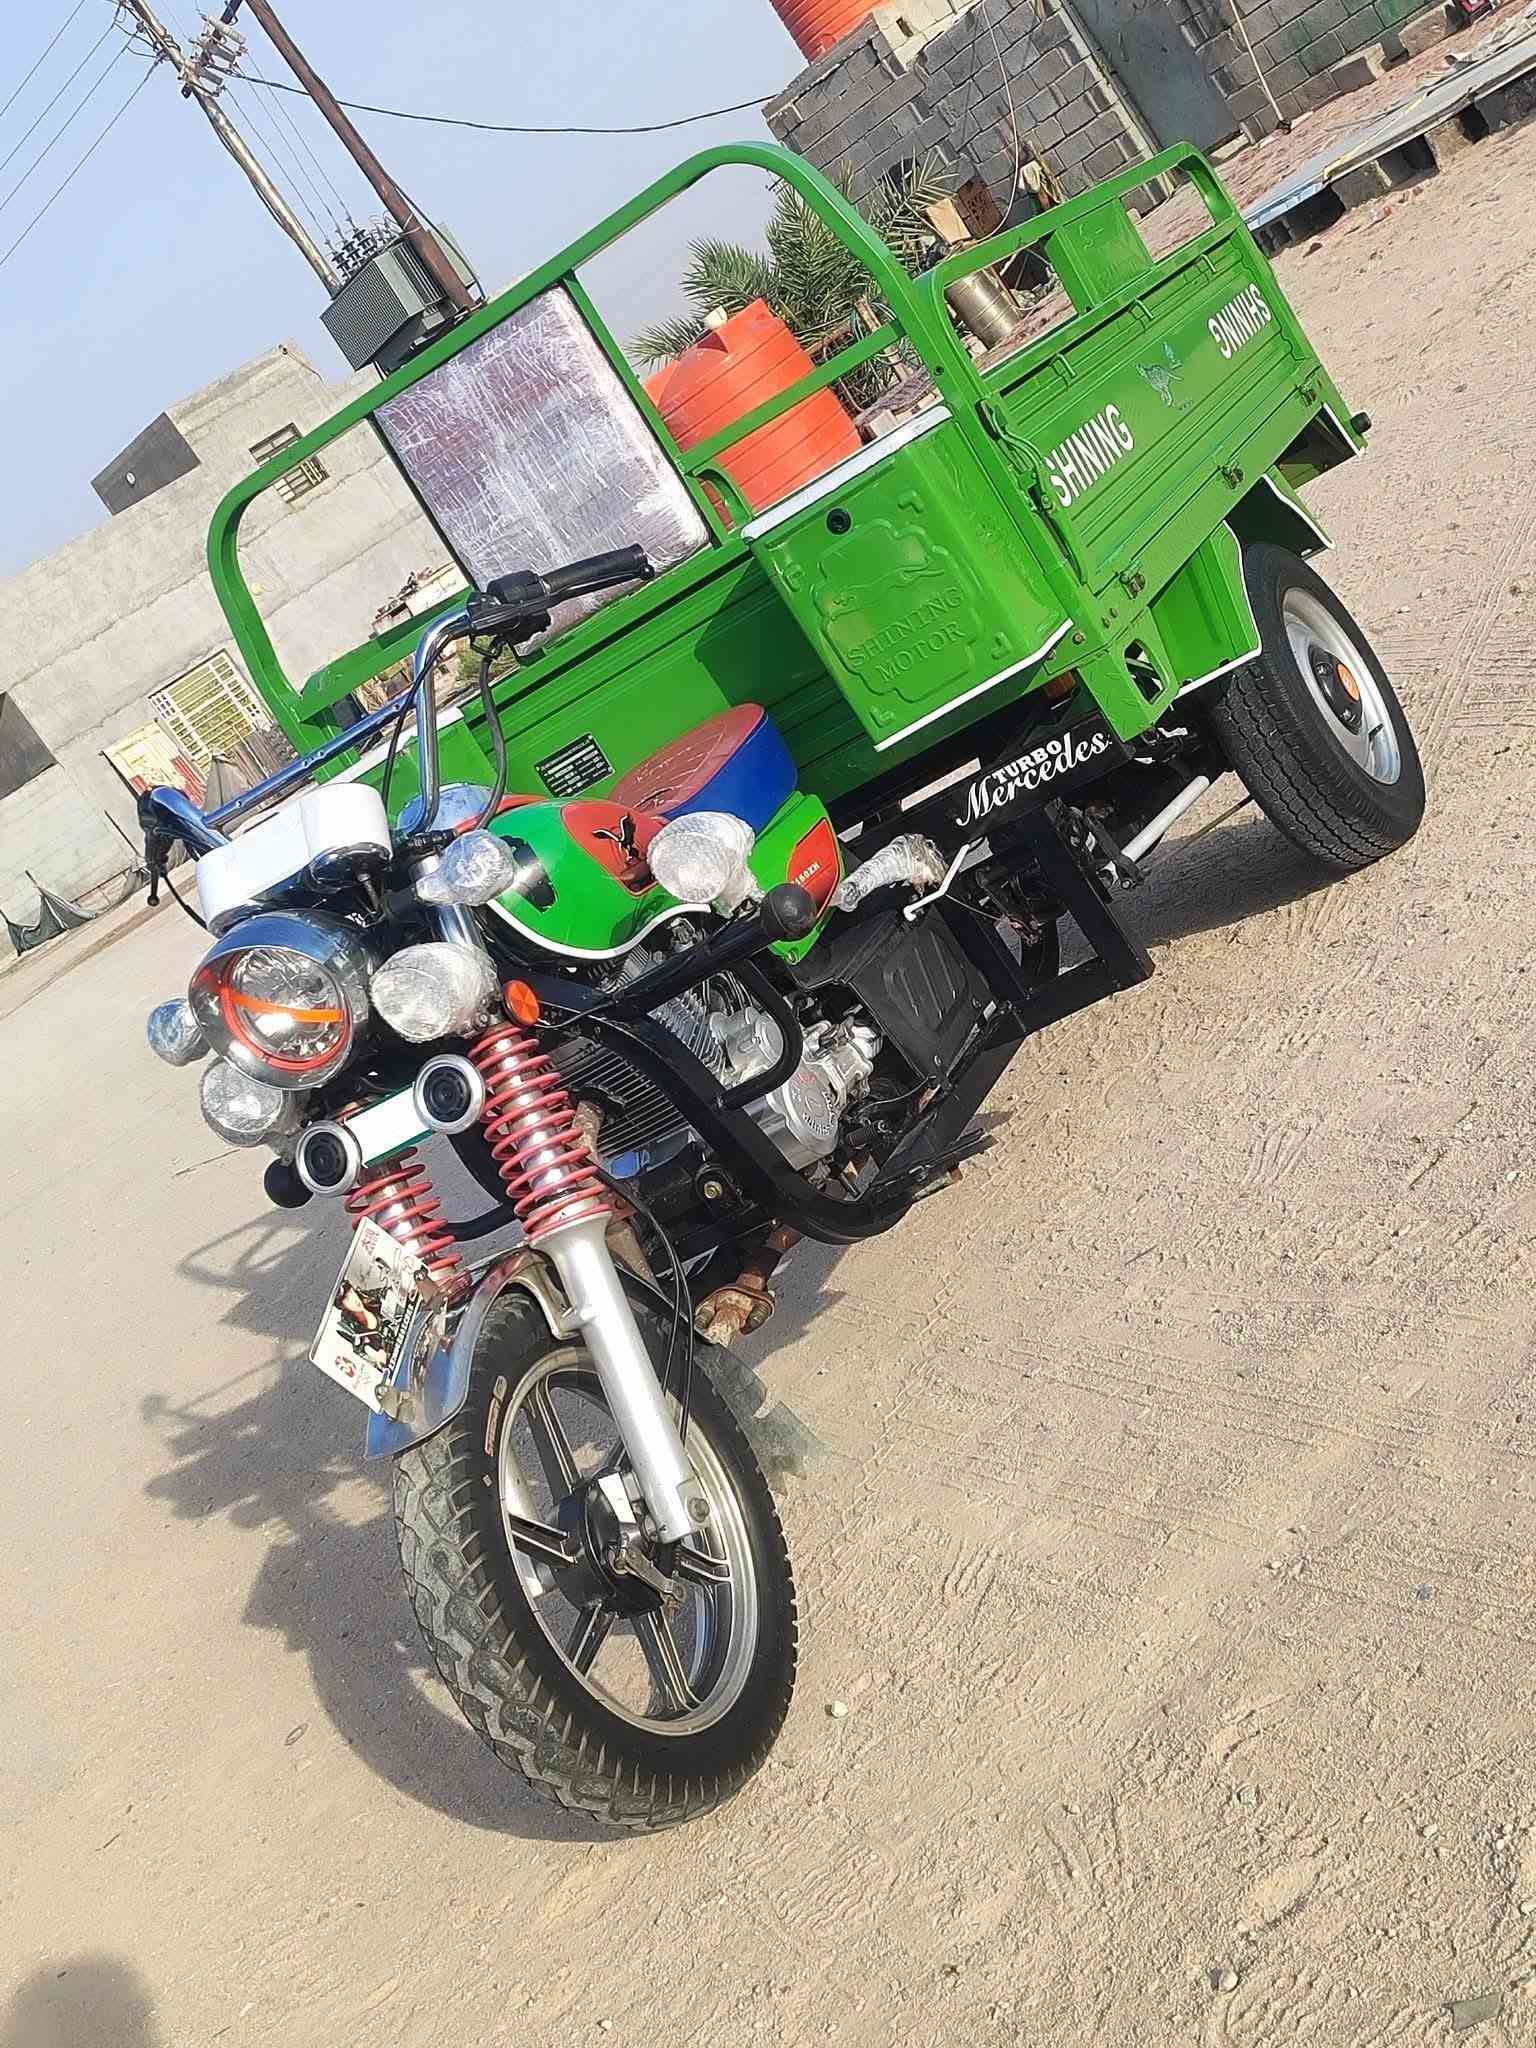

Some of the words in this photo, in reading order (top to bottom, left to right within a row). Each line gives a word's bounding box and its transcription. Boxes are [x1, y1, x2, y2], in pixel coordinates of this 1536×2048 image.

[1208, 283, 1272, 359] SHINING
[1045, 403, 1135, 507] SHINING
[848, 585, 964, 667] SHINING
[876, 620, 967, 682] MOTOR
[955, 731, 1109, 827] Mercedes
[992, 739, 1063, 785] TURBO
